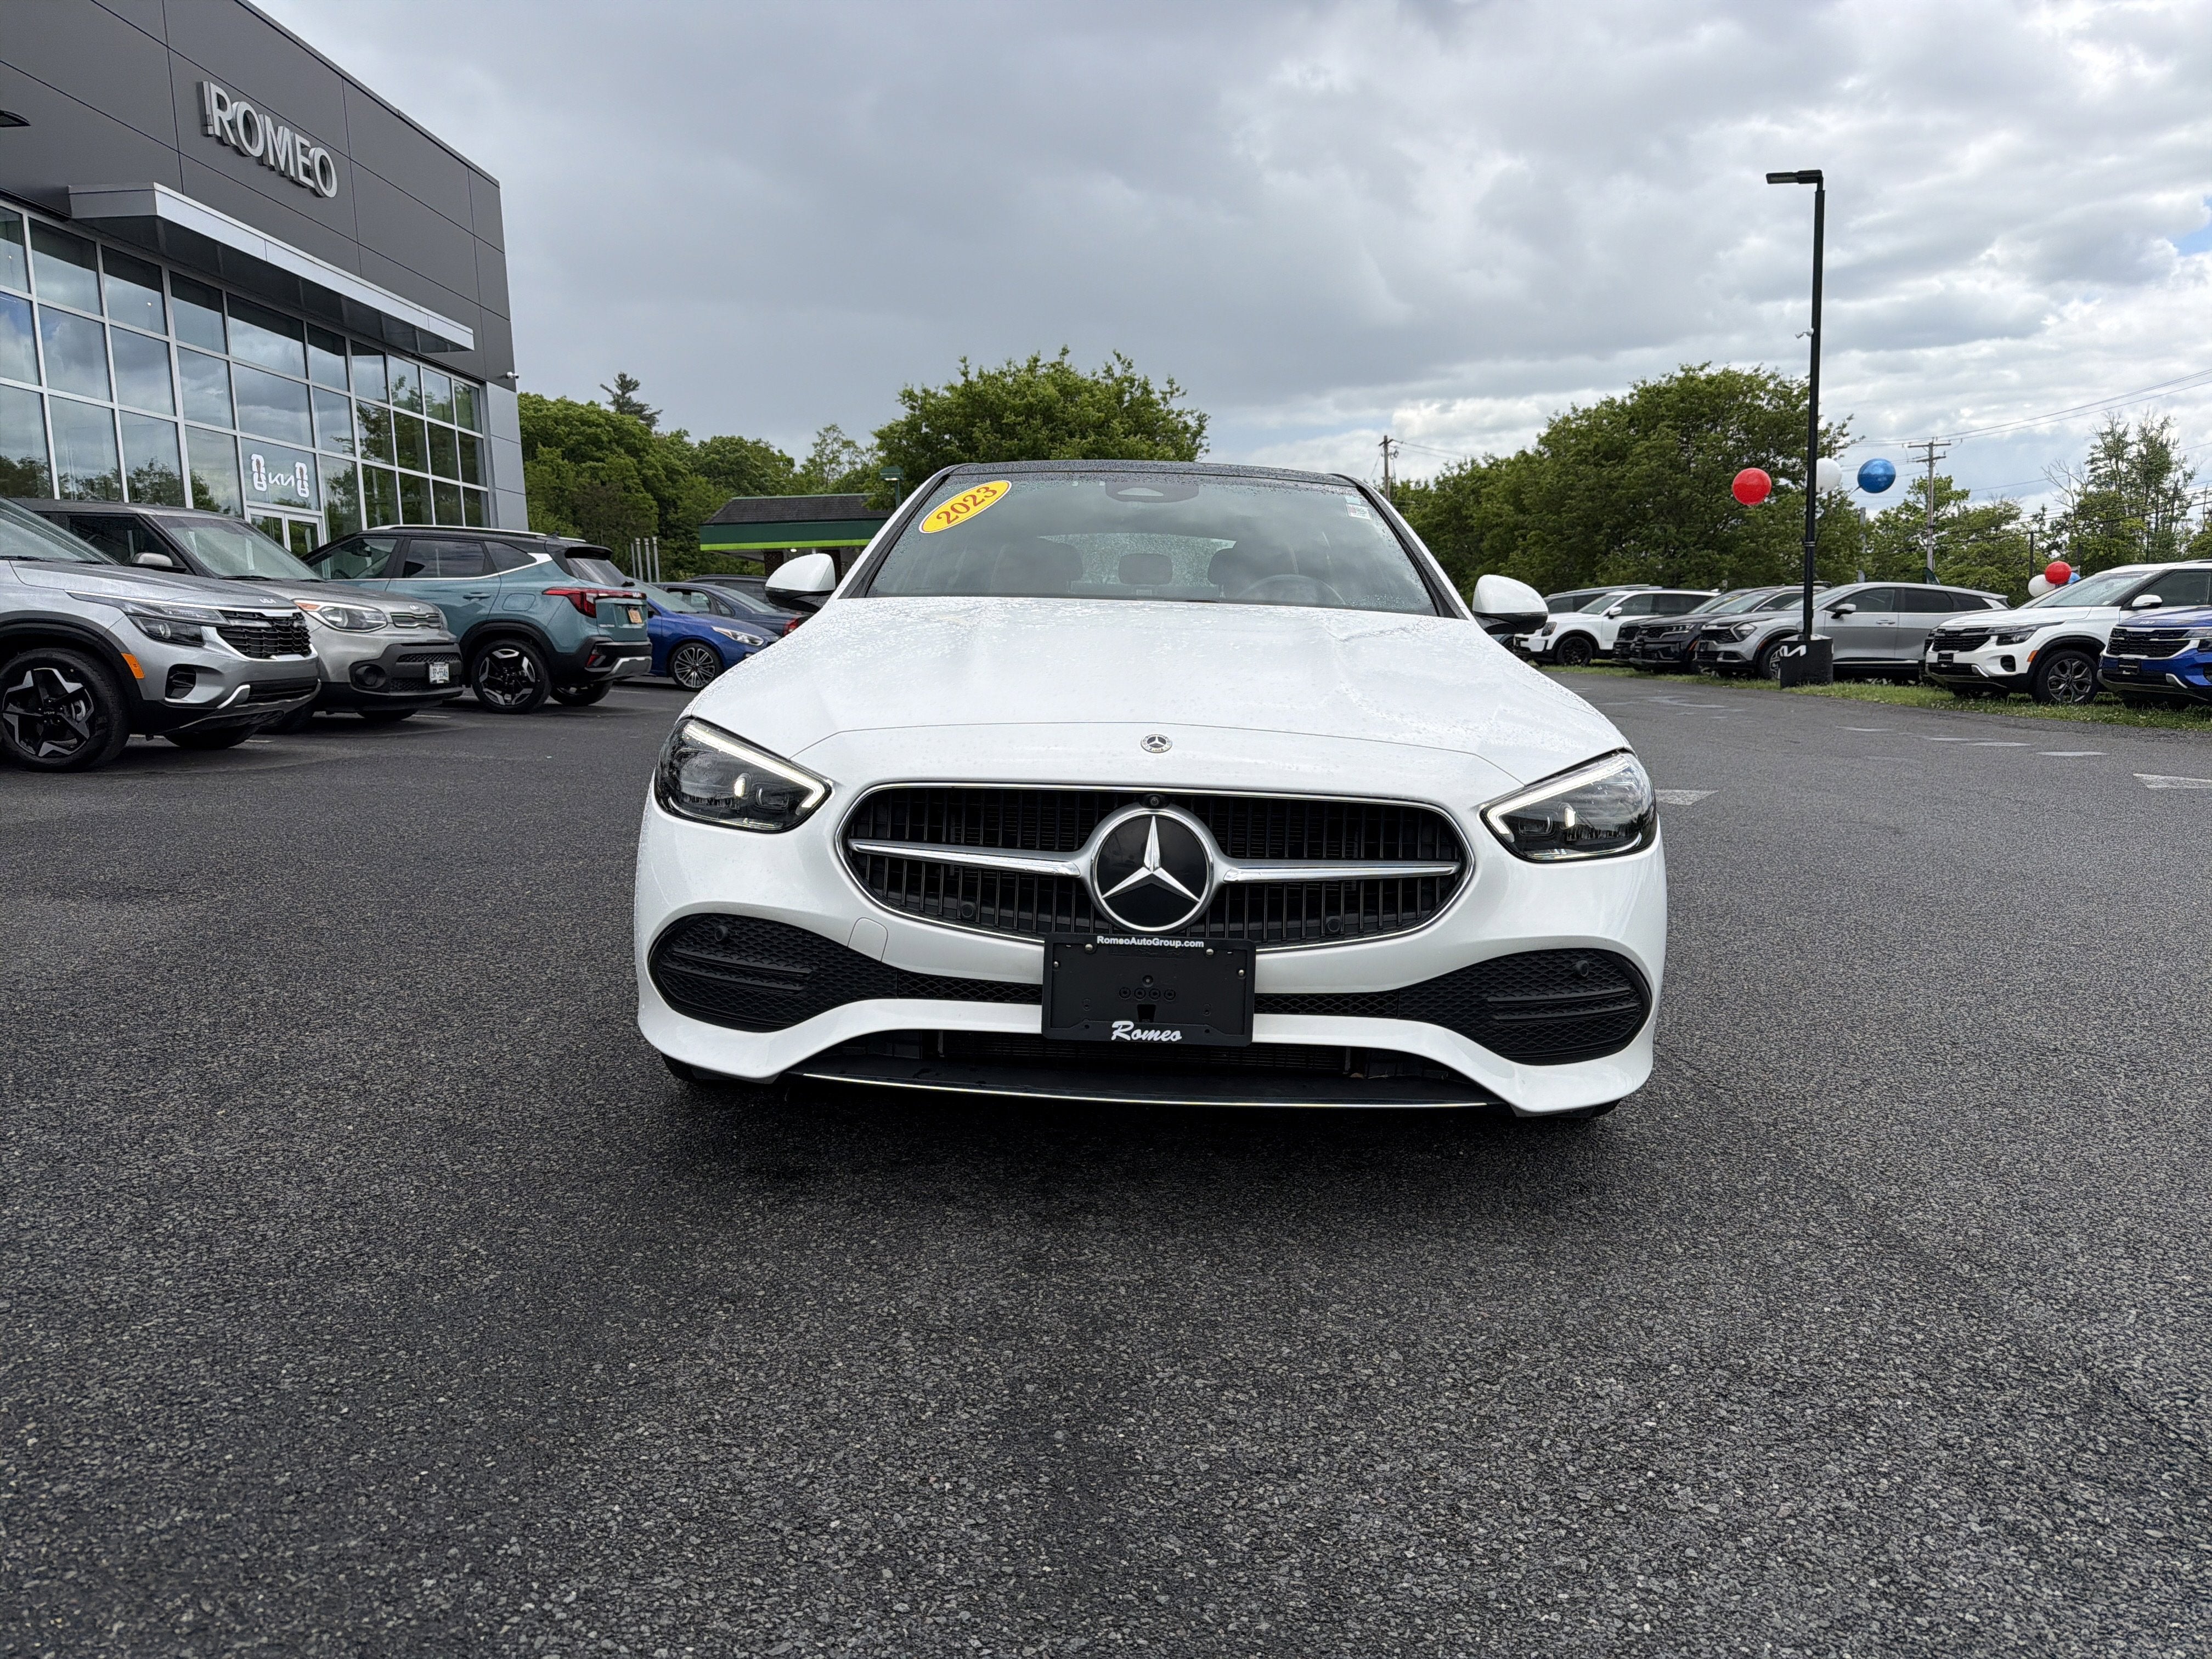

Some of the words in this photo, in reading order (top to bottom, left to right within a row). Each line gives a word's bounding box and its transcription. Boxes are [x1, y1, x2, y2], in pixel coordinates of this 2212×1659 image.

[203, 81, 337, 198] ROMEO
[268, 472, 295, 487] KIA
[936, 487, 997, 524] 2023
[1097, 935, 1204, 948] RomeoAutoGroup.com
[1111, 1020, 1182, 1042] Romeo
